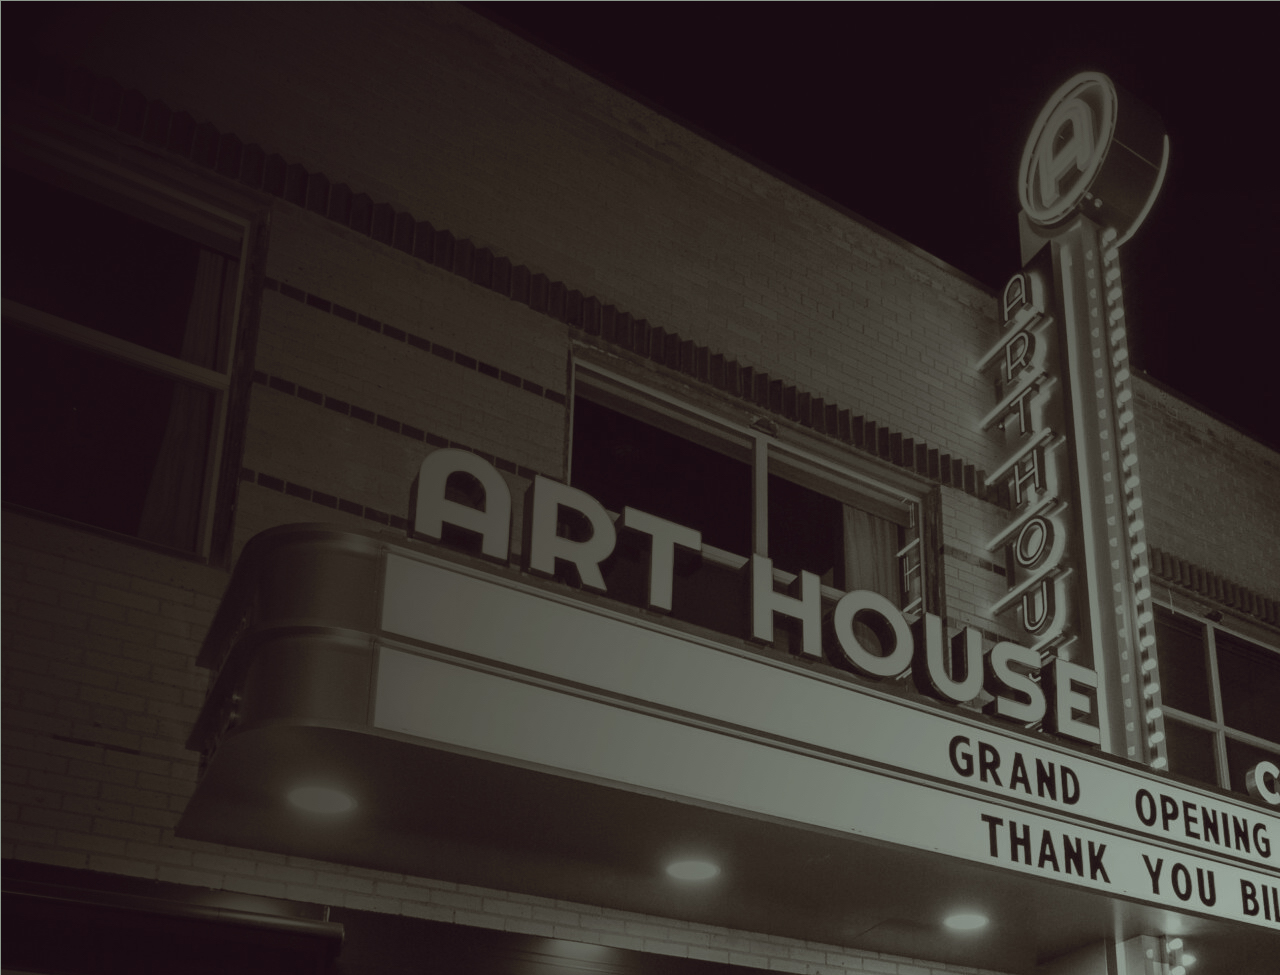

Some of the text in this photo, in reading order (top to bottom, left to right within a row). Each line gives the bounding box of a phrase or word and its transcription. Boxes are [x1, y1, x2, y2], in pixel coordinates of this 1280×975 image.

[1038, 98, 1096, 208] A
[413, 448, 1101, 745] ART HOUSE
[948, 735, 1080, 806] GRAND
[1135, 788, 1272, 858] OPENING
[981, 813, 1111, 884] THANK
[1142, 853, 1217, 907] YOU
